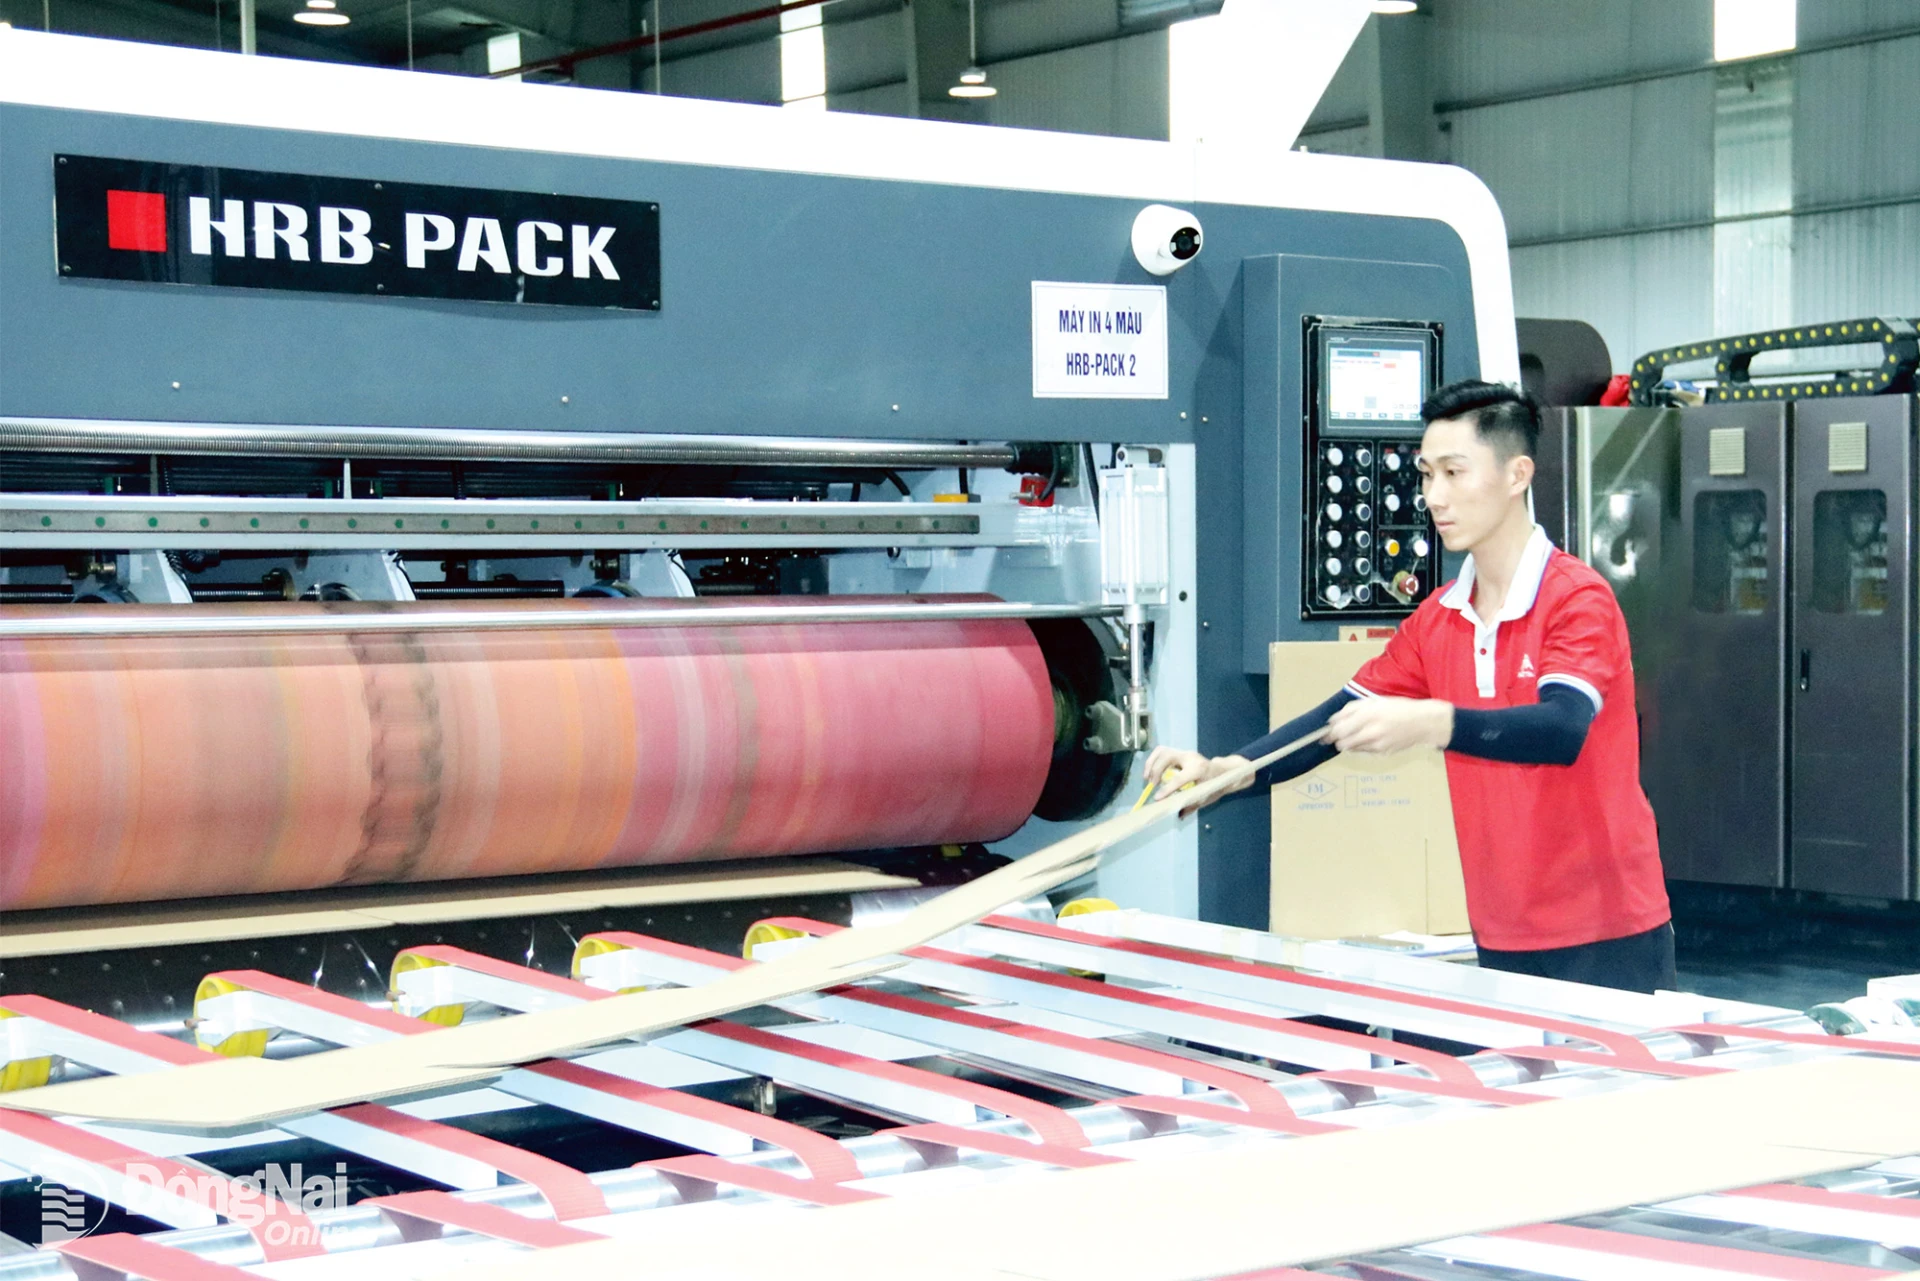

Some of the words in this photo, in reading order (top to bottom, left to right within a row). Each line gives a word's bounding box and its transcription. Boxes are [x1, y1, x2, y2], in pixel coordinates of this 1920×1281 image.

[189, 196, 374, 265] HRB
[405, 213, 621, 281] PACK
[1059, 304, 1084, 333] MÁY
[1089, 311, 1101, 333] IN
[1105, 311, 1112, 334] 4
[1116, 306, 1142, 334] MÀU
[1066, 352, 1125, 377] HRB-PACK
[1130, 354, 1136, 376] 2
